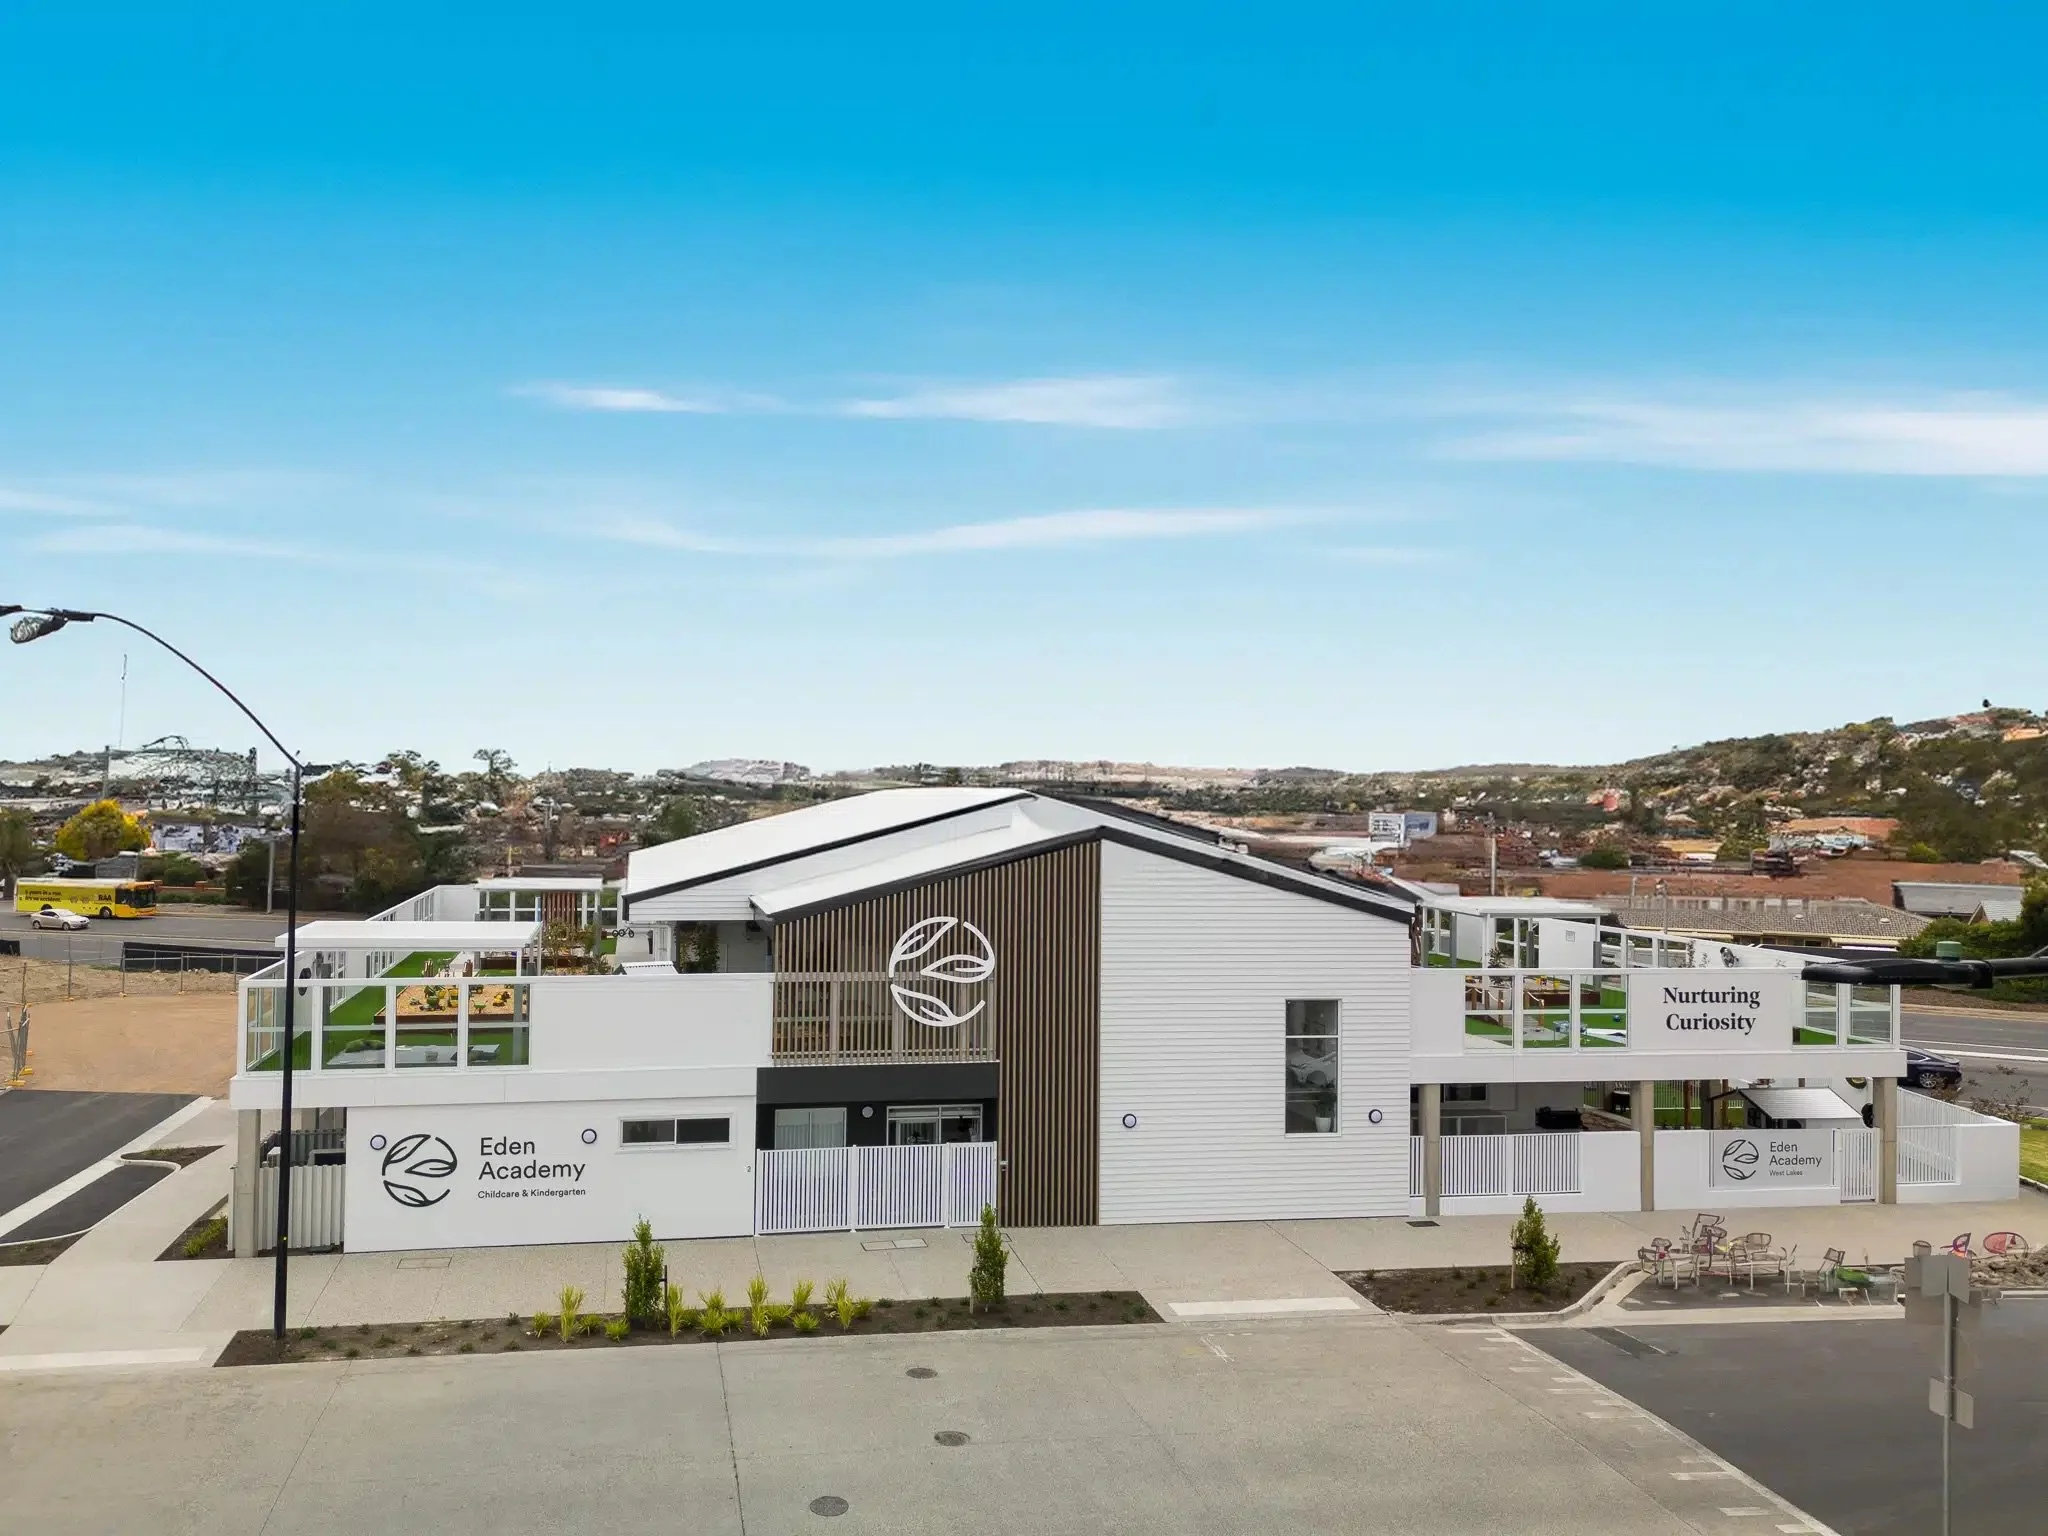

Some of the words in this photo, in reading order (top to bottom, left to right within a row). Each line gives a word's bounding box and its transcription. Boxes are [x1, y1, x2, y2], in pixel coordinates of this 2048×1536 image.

[1663, 985, 1761, 1009] Nurturing
[1666, 1012, 1757, 1036] Curiosity
[480, 1136, 536, 1156] Eden
[1770, 1141, 1798, 1152] Eden
[478, 1159, 586, 1182] Academy
[1769, 1154, 1822, 1168] Academy
[478, 1190, 520, 1199] Childcare
[522, 1189, 529, 1197] &
[530, 1188, 586, 1198] Kindergarten
